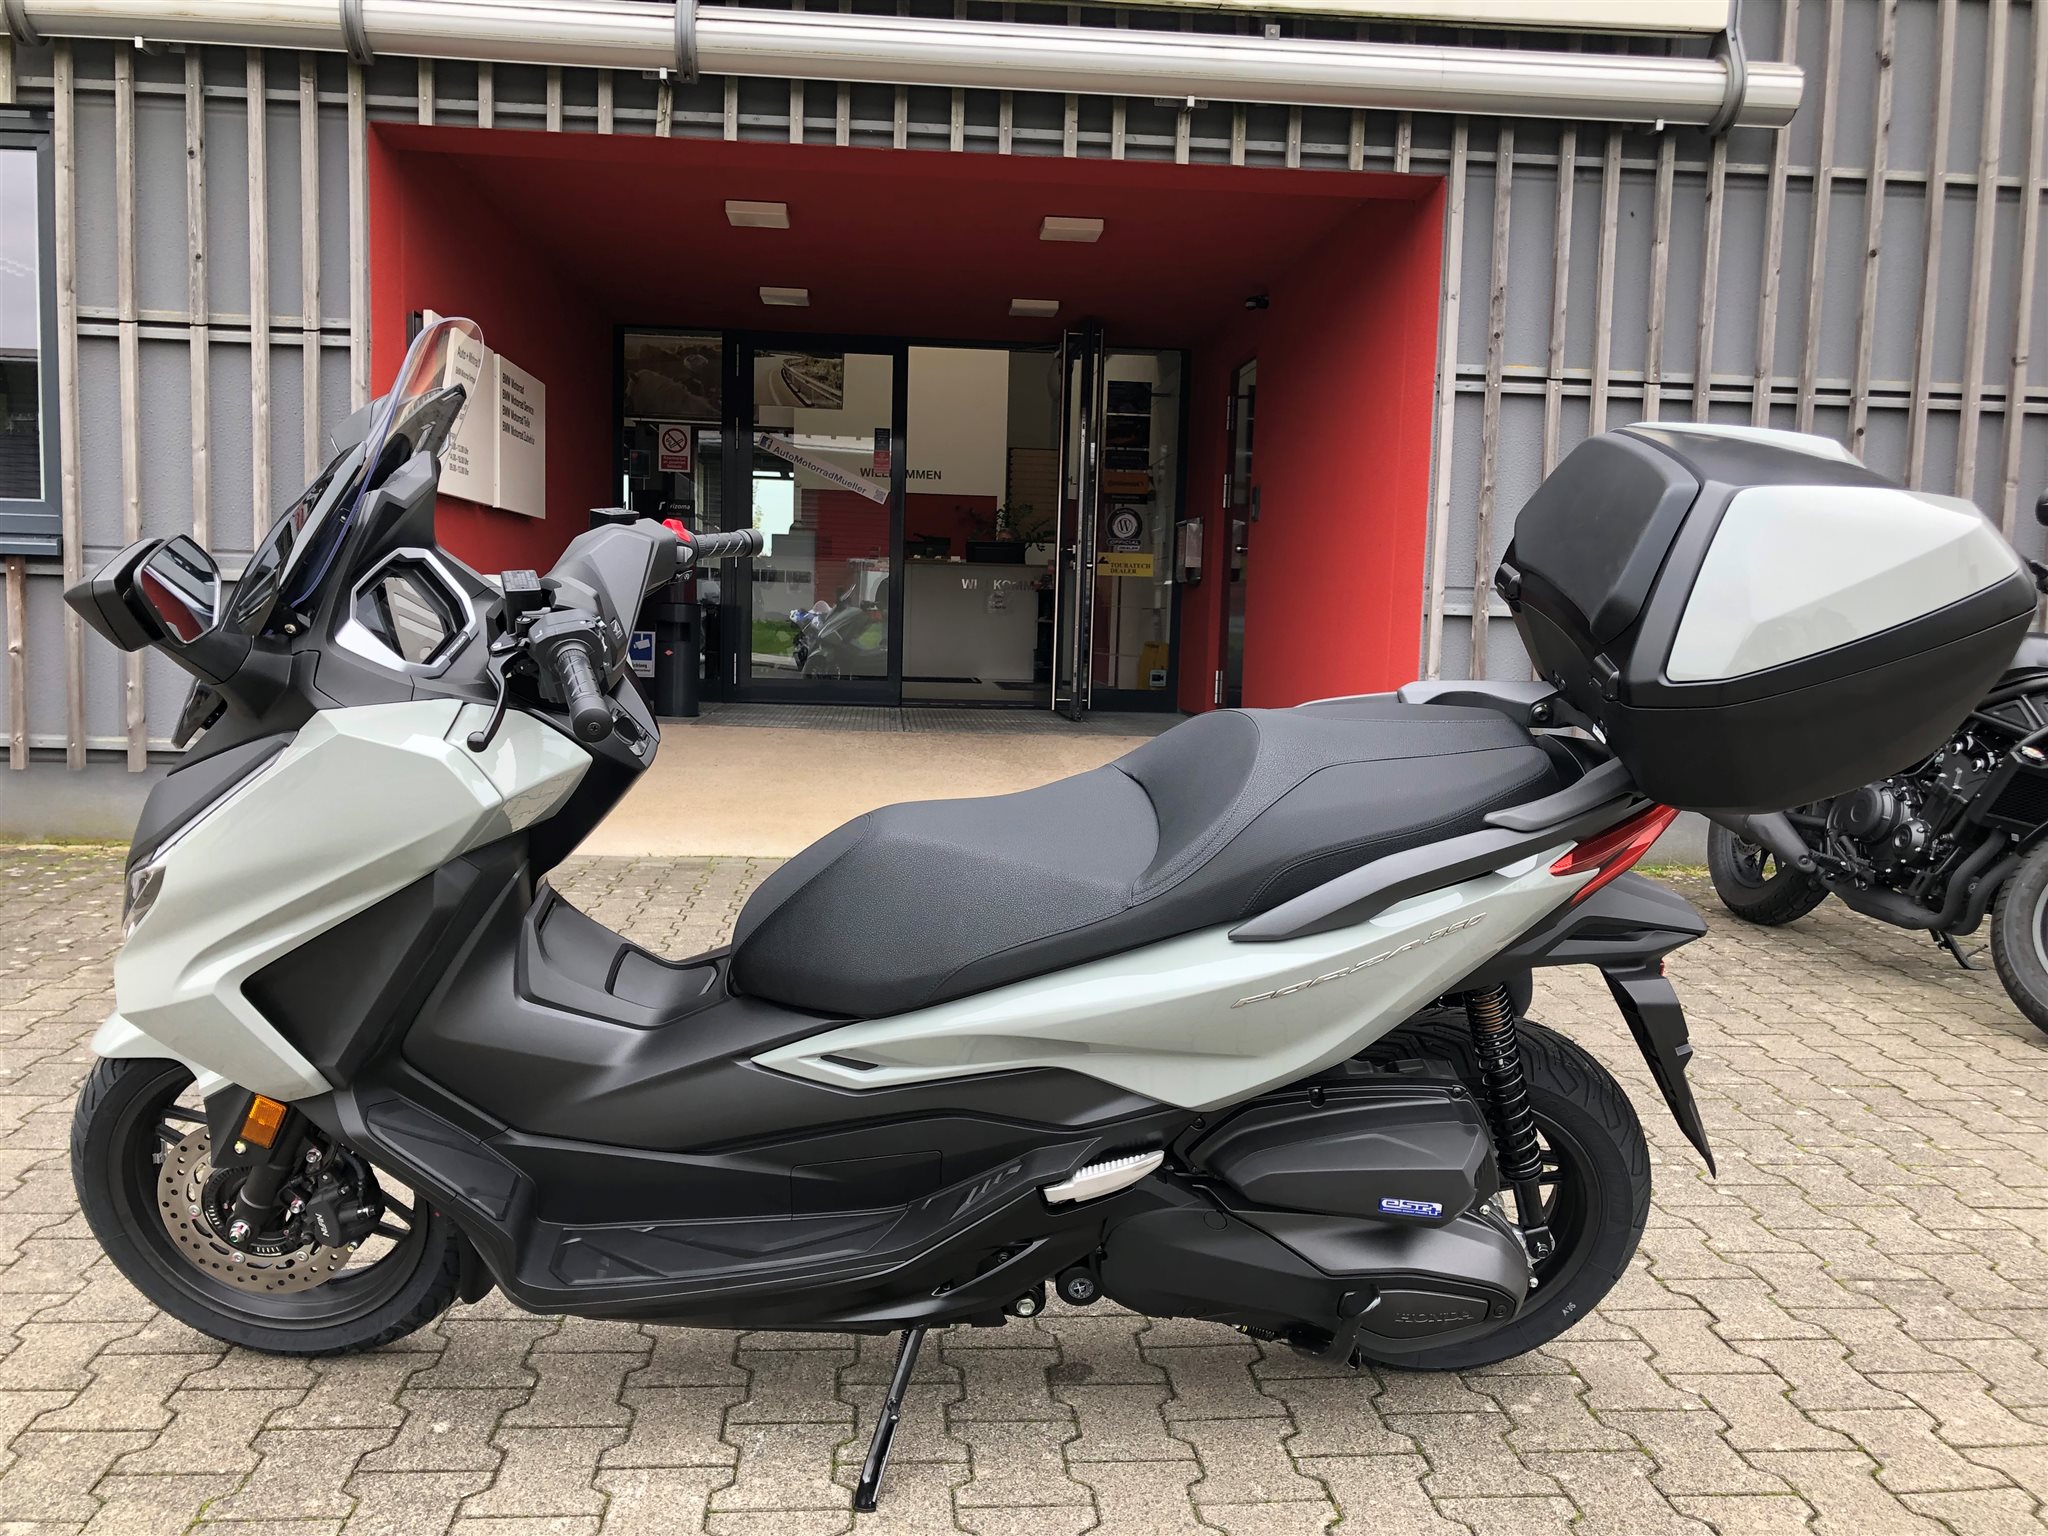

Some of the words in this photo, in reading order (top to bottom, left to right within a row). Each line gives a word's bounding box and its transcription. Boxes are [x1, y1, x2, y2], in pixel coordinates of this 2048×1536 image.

[773, 446, 867, 494] AutoMotorradMueller
[669, 502, 691, 510] rizoma
[1231, 939, 1421, 1009] FORZA
[1421, 912, 1488, 945] 350
[1394, 1311, 1475, 1323] HONDA
